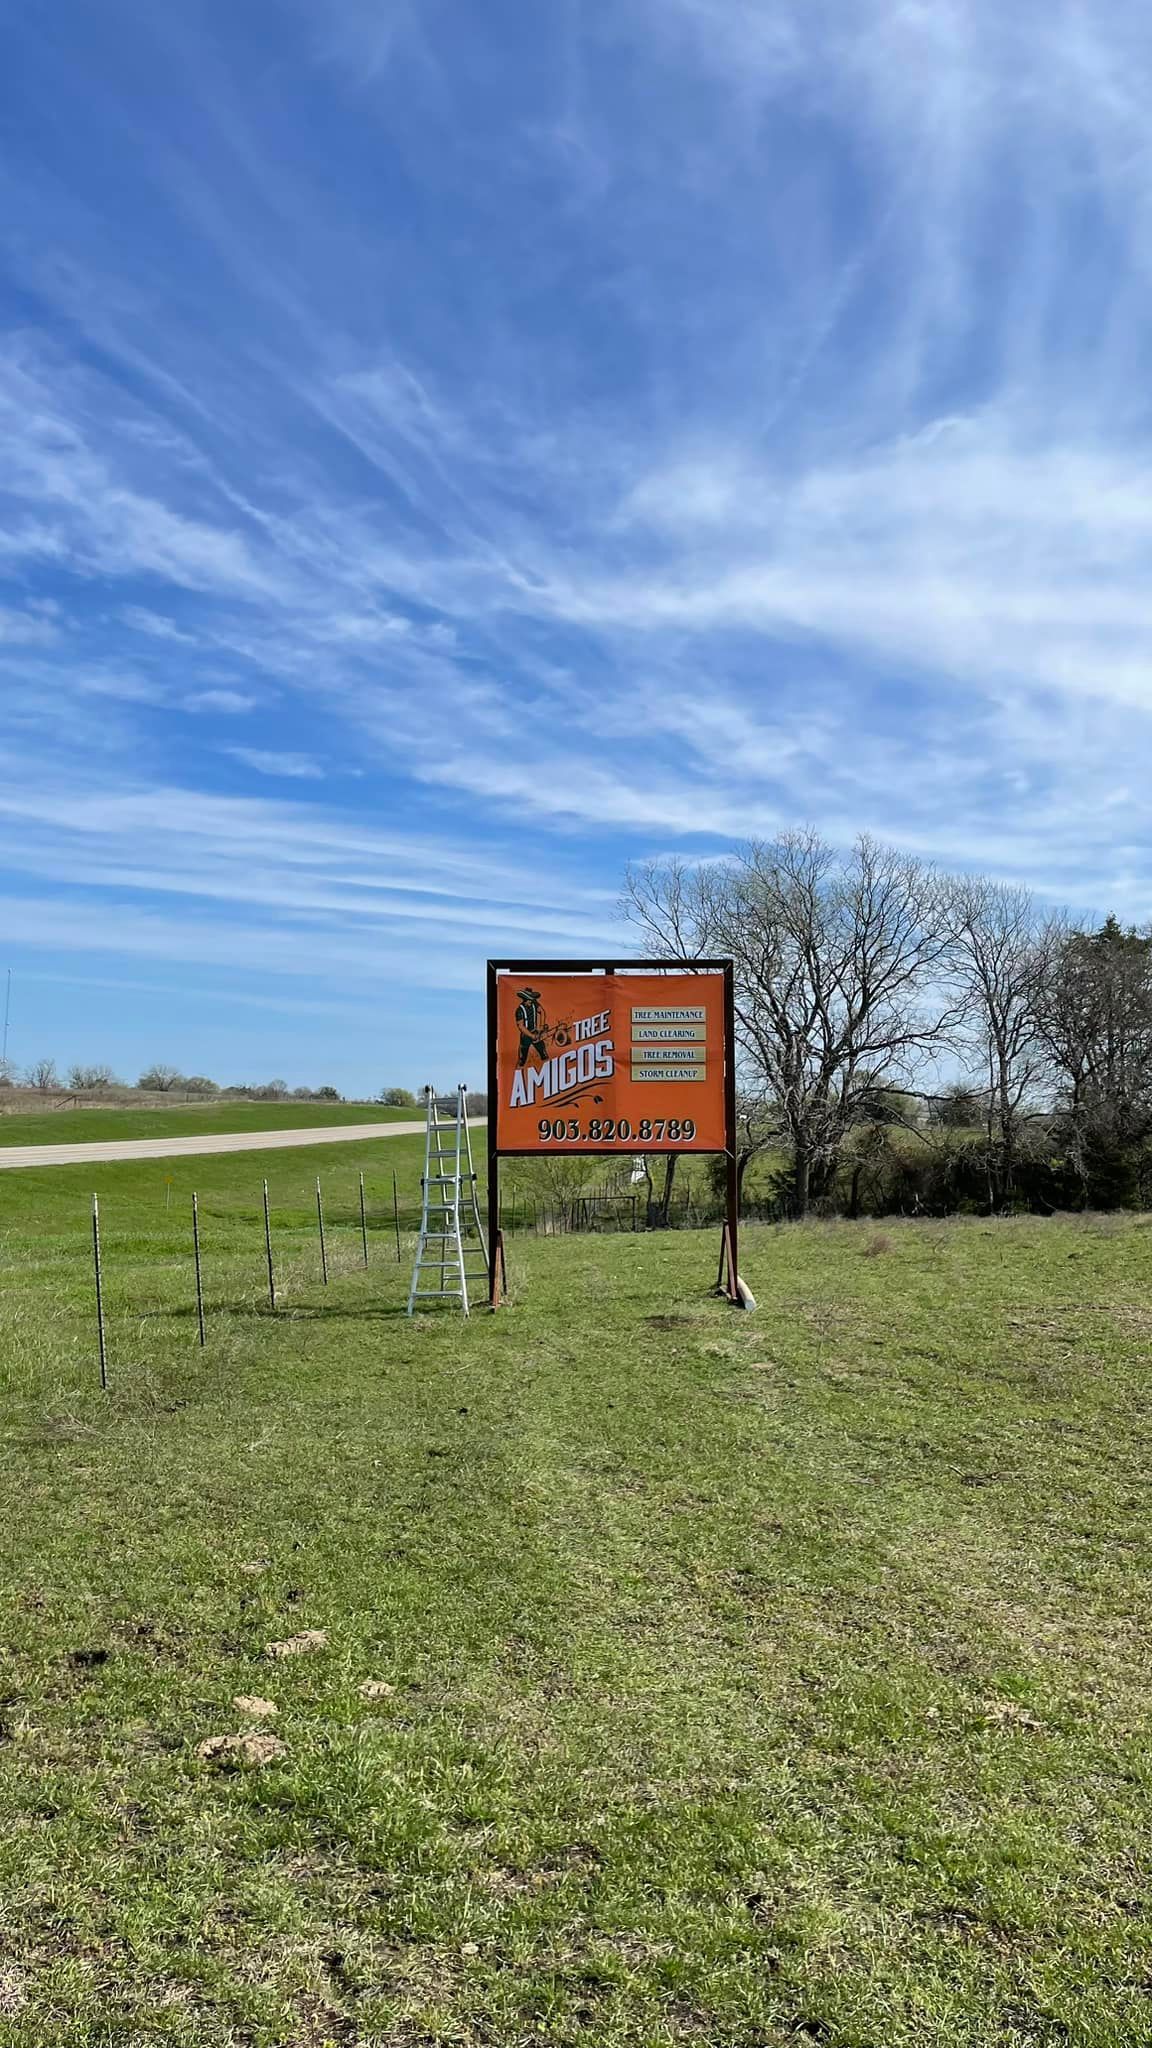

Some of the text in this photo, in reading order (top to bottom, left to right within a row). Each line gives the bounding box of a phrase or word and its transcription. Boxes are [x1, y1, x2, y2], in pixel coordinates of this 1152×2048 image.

[634, 1011, 703, 1019] TREE MAINTENANCE
[573, 1009, 611, 1042] TREE
[639, 1030, 695, 1038] LAND CLEARING
[643, 1051, 695, 1059] TREE REMOVAL
[509, 1039, 615, 1109] AMIGOS
[639, 1070, 698, 1078] STORM CLEANUP
[538, 1118, 697, 1142] 903.820.8789
